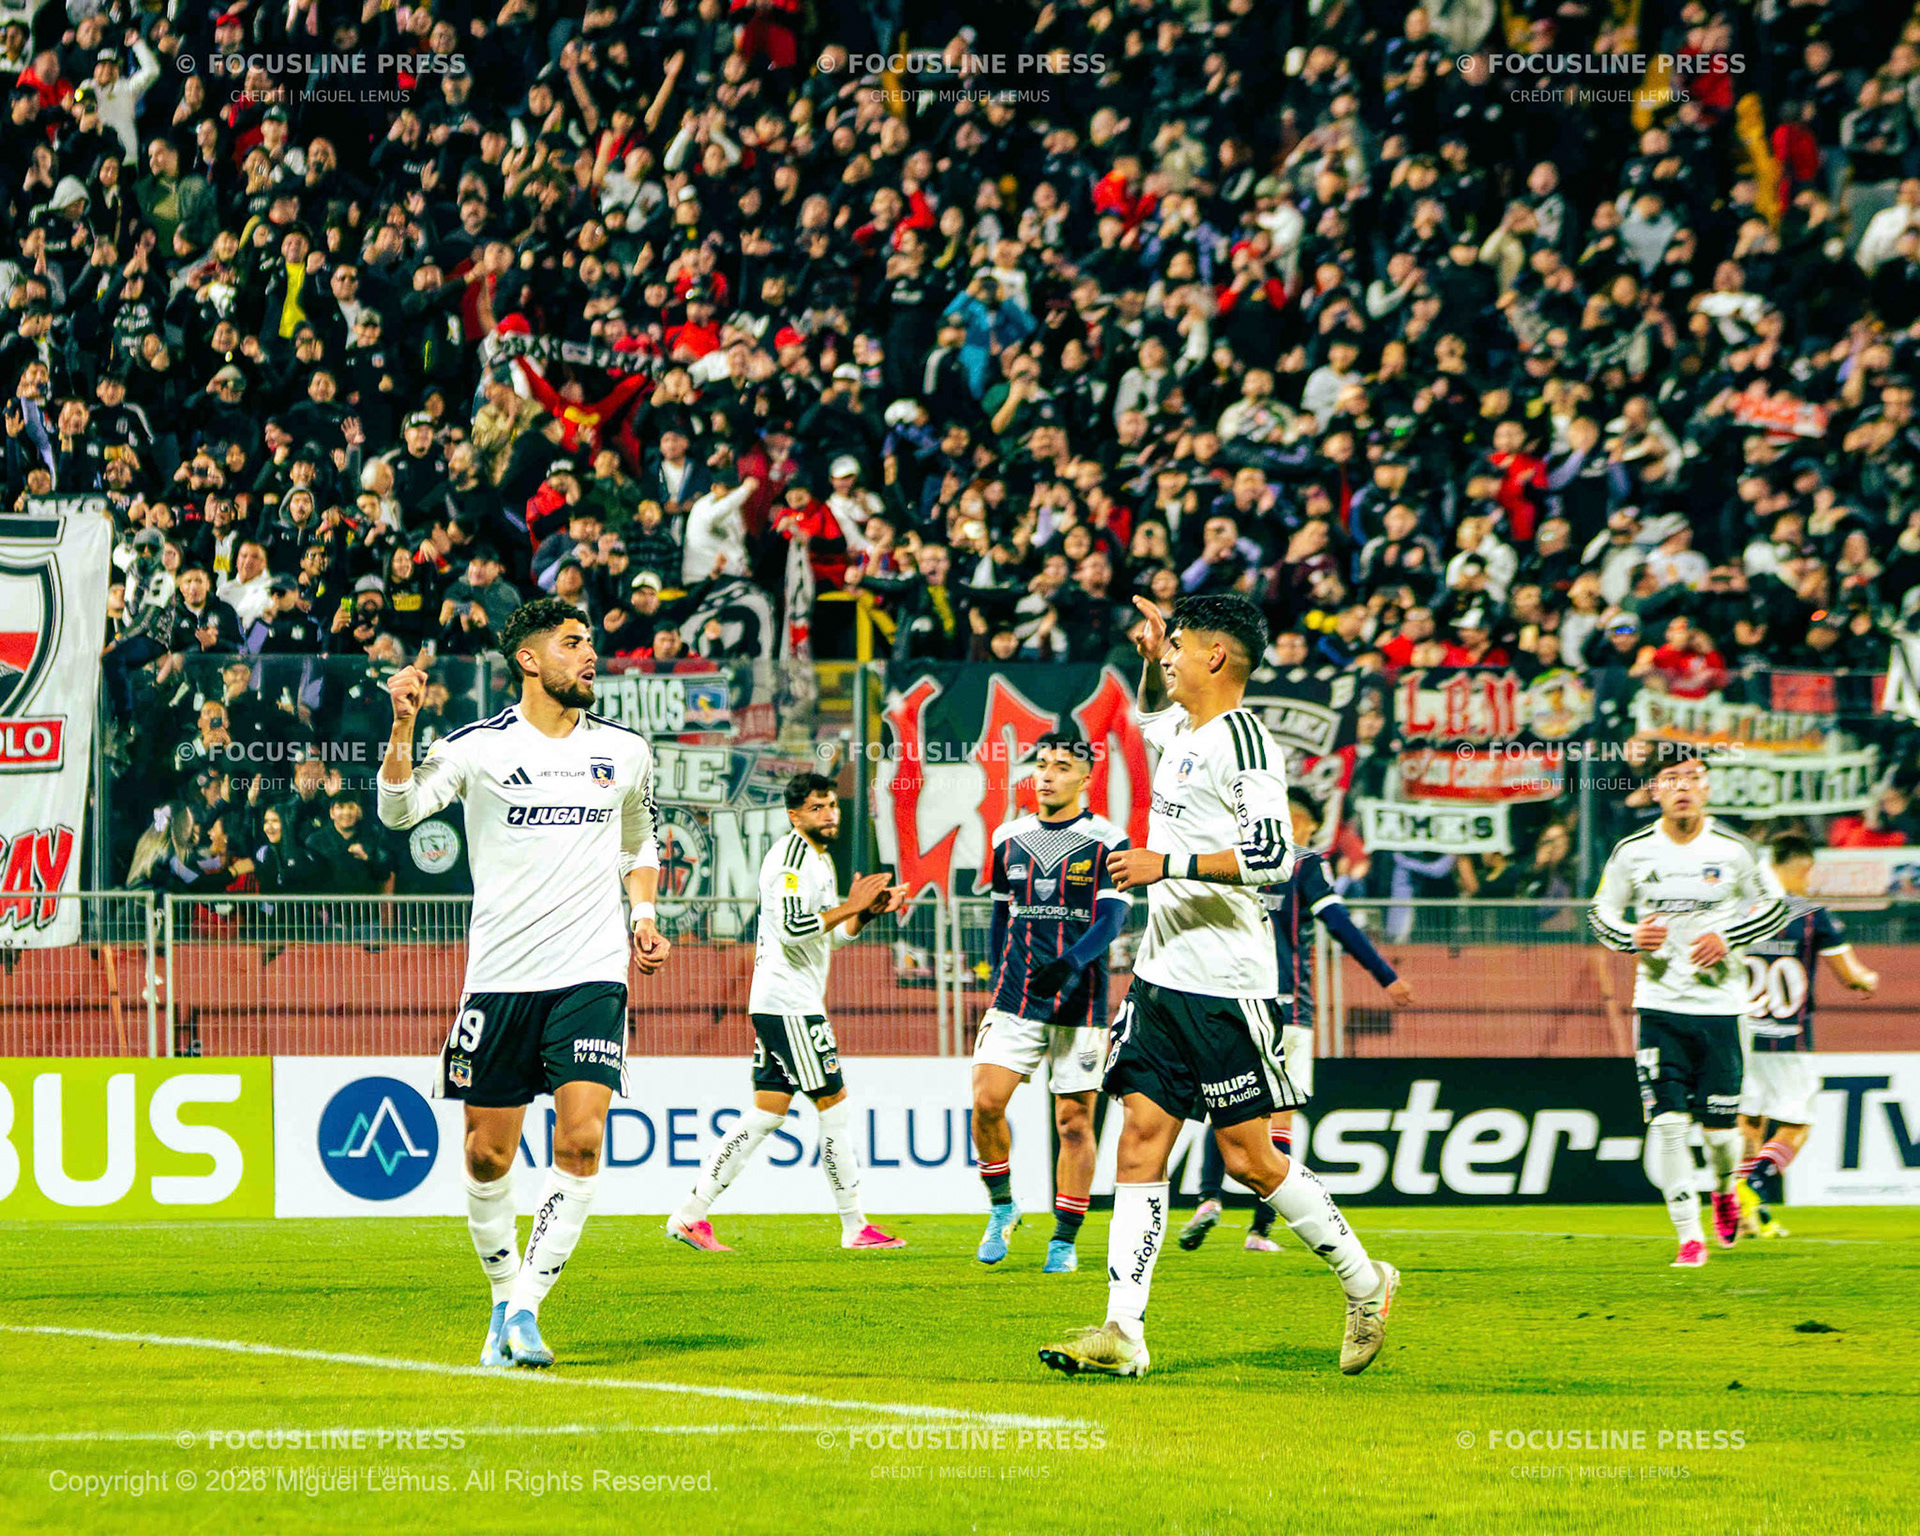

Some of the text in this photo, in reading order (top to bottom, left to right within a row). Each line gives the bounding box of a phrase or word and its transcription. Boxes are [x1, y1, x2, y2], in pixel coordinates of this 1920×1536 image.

[0, 727, 52, 757] LO
[536, 770, 586, 778] JETOUR
[528, 808, 613, 824] JUGA BET
[0, 824, 75, 930] AY
[573, 1051, 585, 1064] TV
[587, 1051, 597, 1062] &
[1201, 1070, 1257, 1096] PHILIPS
[1217, 1096, 1228, 1108] &
[1229, 1086, 1261, 1106] Audio
[0, 1072, 244, 1207] US
[1129, 1195, 1162, 1287] AutoPlanet
